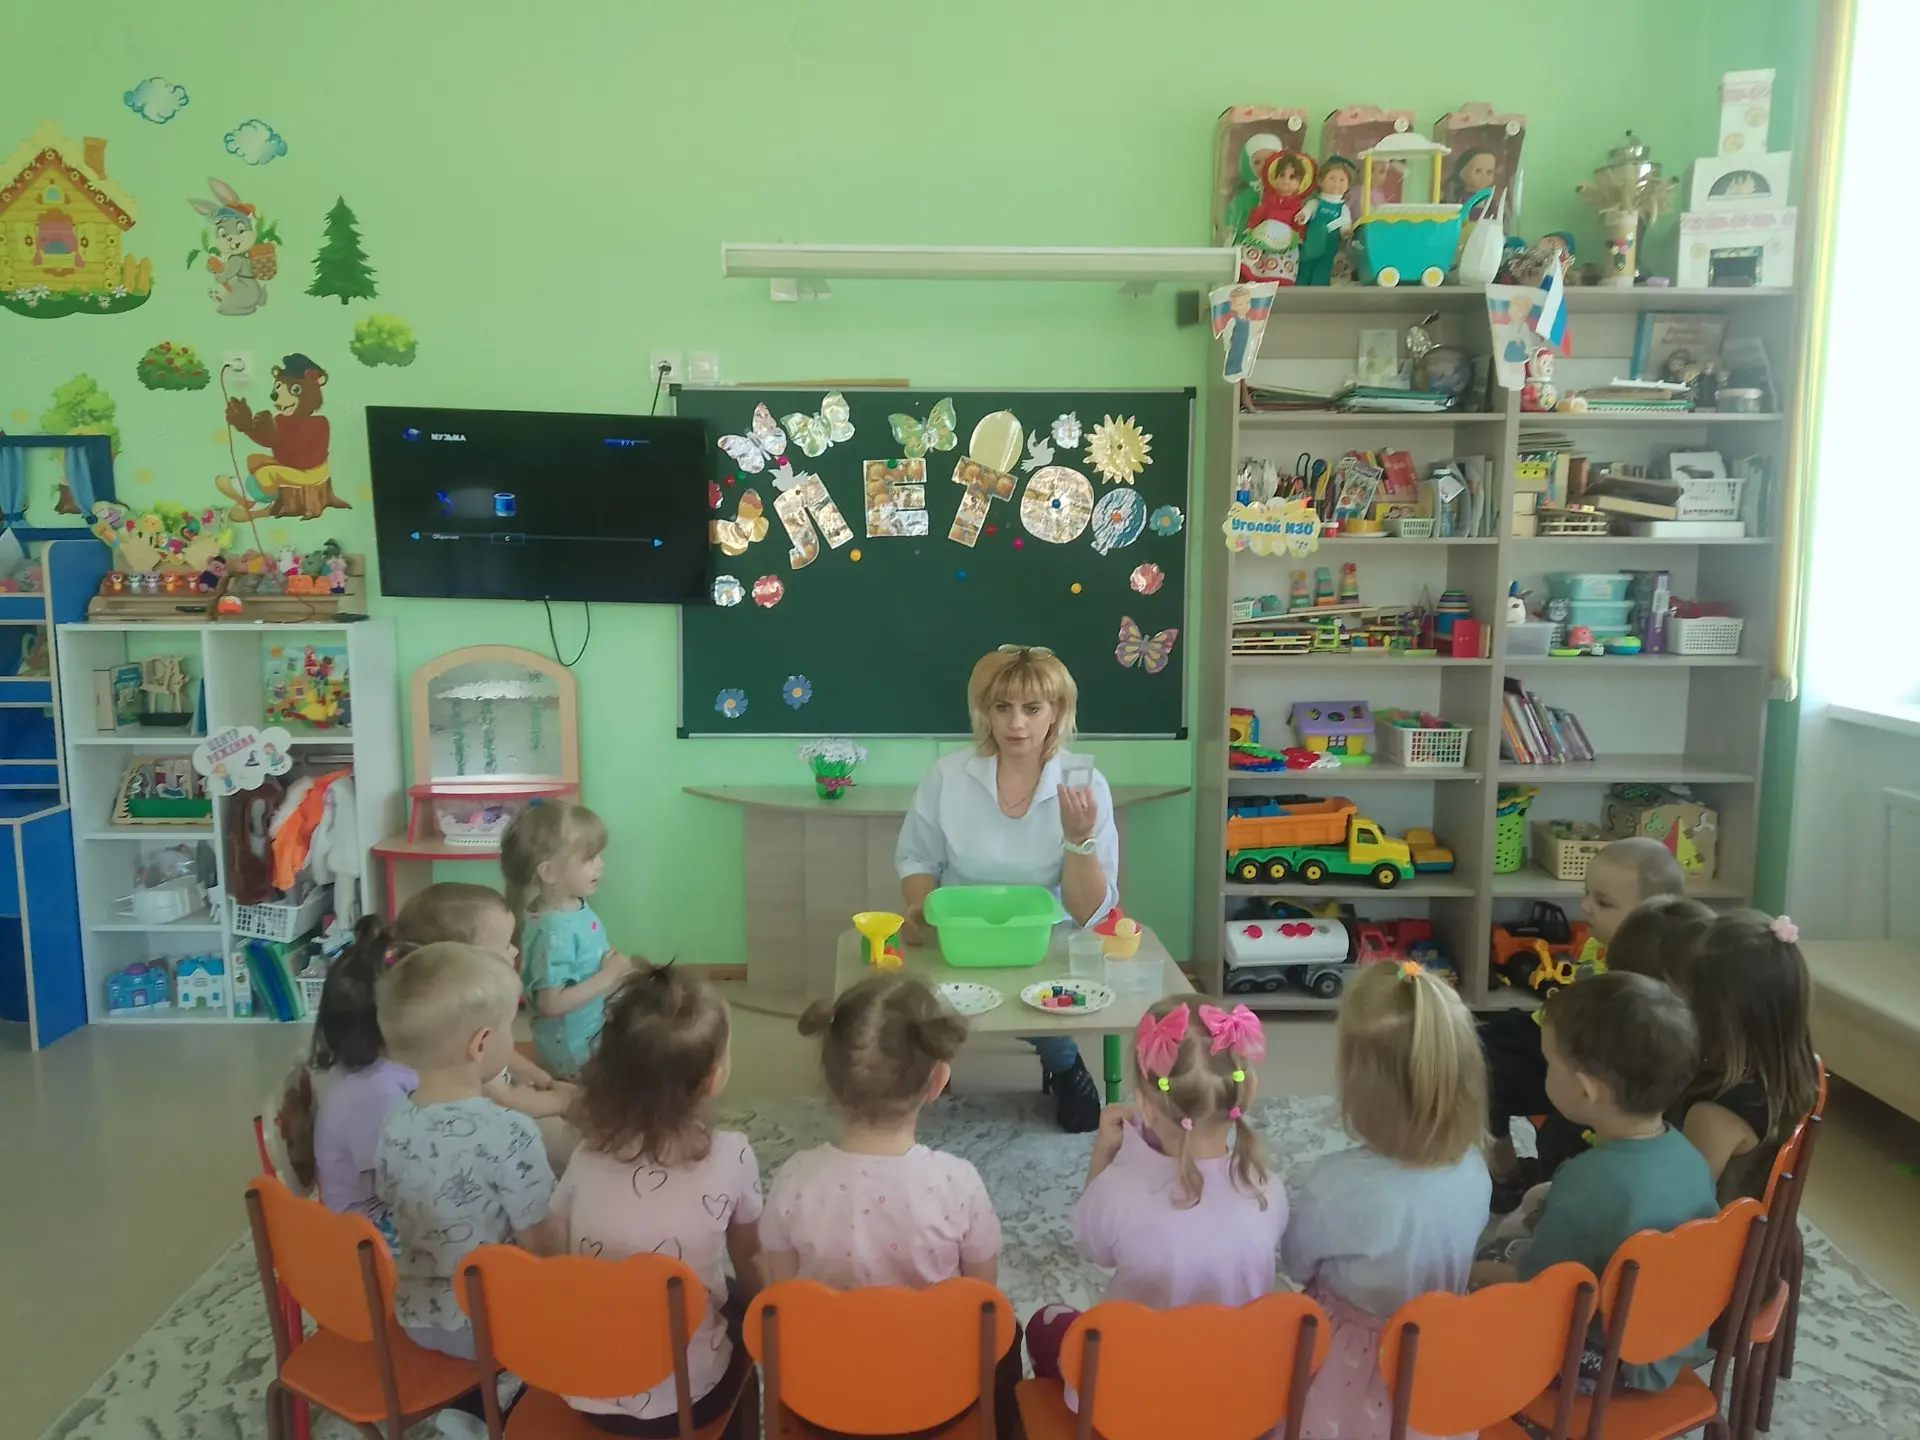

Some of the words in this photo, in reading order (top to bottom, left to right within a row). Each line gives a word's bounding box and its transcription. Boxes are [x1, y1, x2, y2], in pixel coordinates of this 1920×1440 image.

[773, 455, 1095, 570] ЛЕТО
[1231, 517, 1282, 534] Уголок
[1284, 521, 1315, 535] ИЗО
